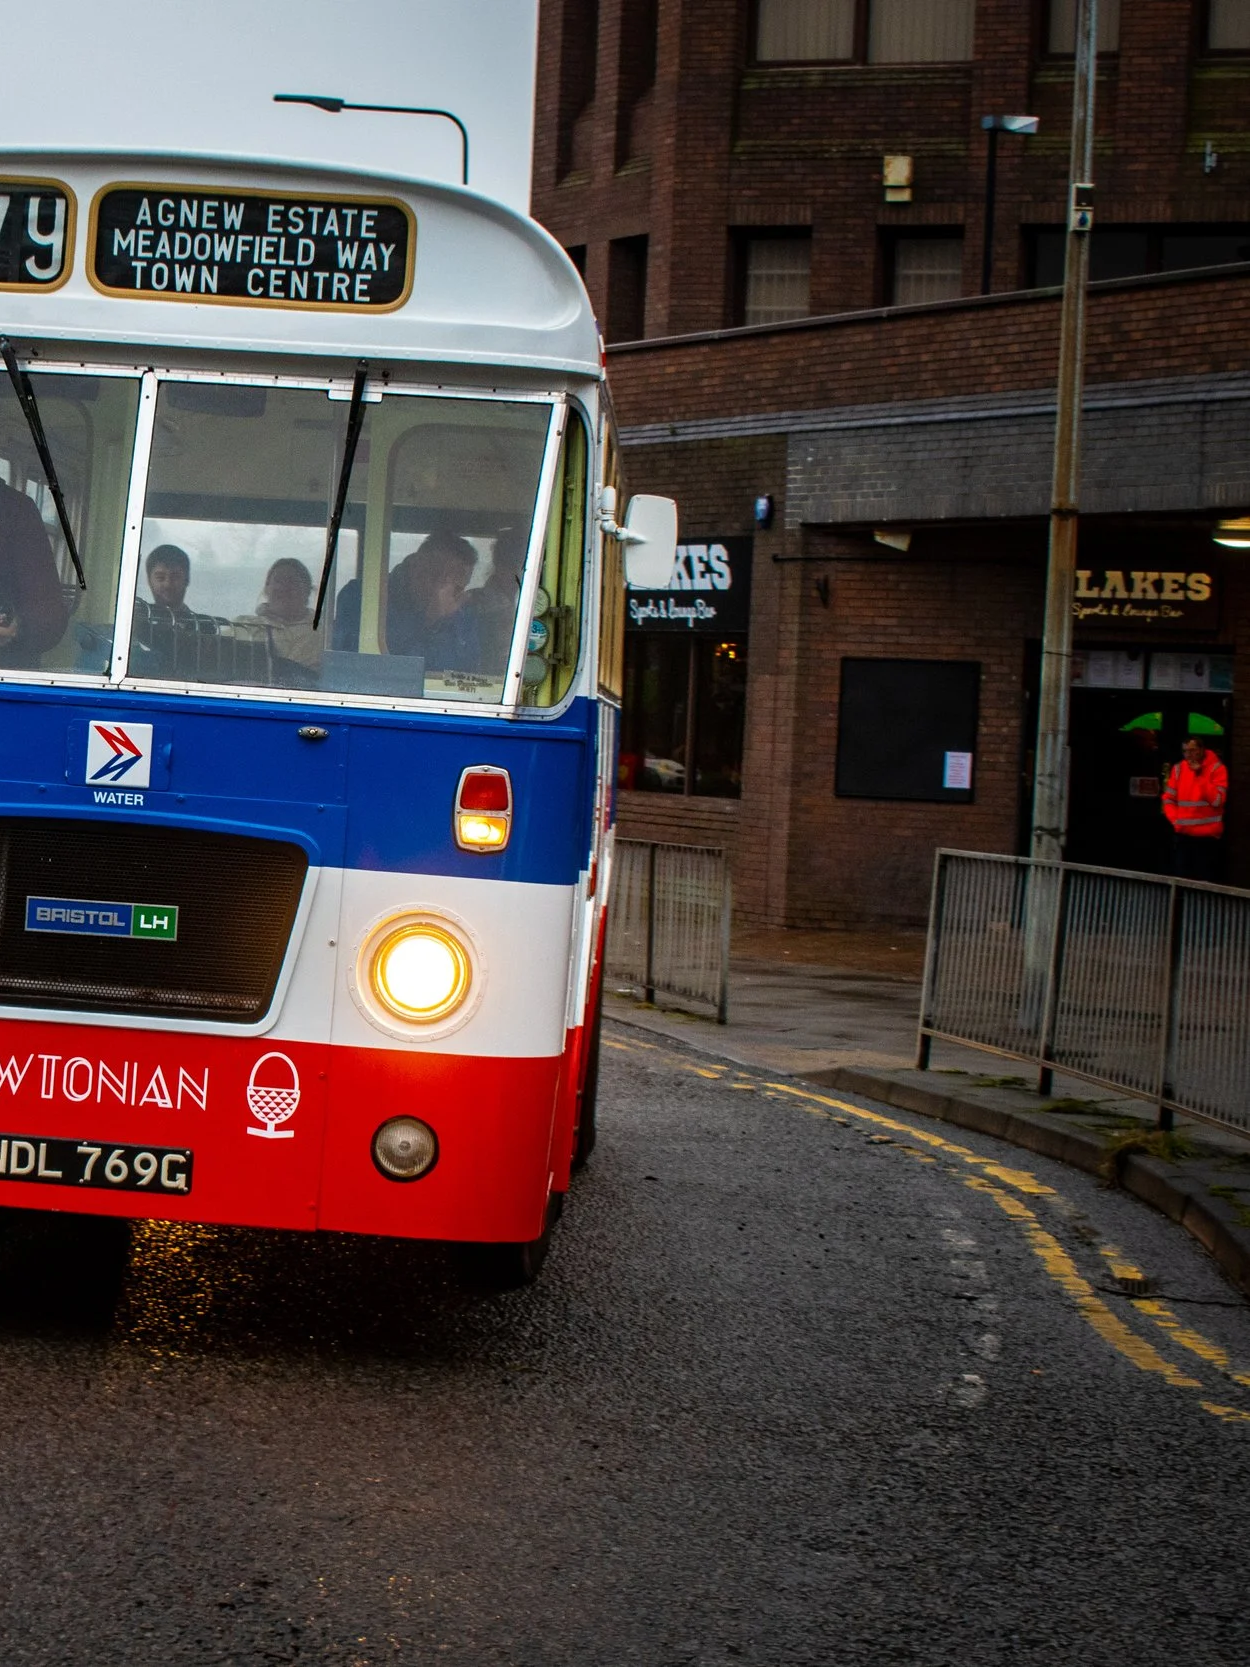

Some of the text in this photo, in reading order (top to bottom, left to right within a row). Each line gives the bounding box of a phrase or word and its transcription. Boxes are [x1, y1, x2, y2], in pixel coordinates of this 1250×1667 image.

[135, 197, 379, 238] AGNEW ESTATE
[112, 228, 396, 271] MEADOWFIELD WAY
[131, 261, 372, 302] TOWN CENTRE
[669, 544, 732, 591] KES
[93, 791, 144, 807] WATER
[36, 906, 168, 930] BRISTOL LH
[76, 1145, 187, 1190] 769G
